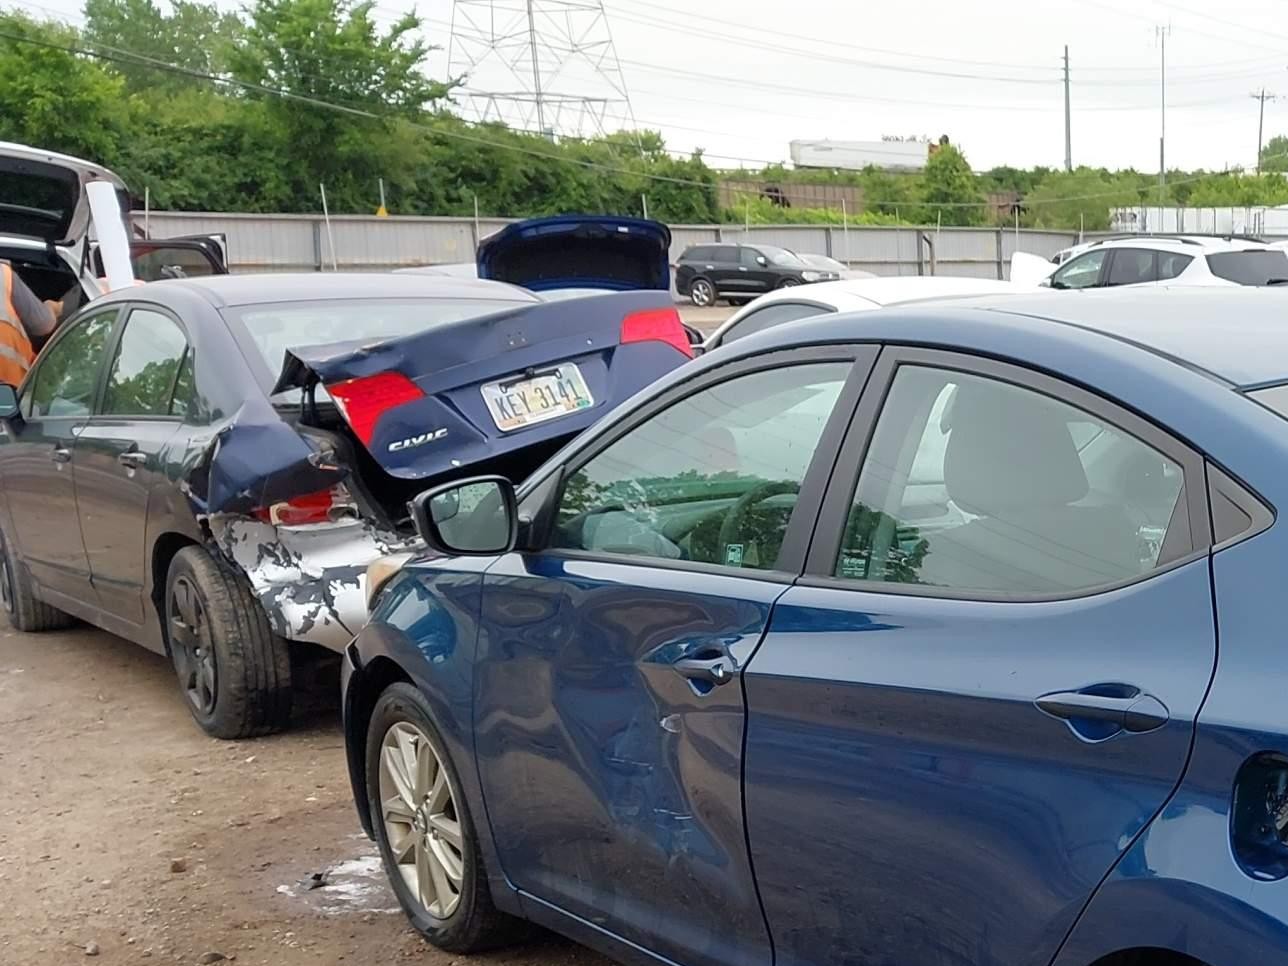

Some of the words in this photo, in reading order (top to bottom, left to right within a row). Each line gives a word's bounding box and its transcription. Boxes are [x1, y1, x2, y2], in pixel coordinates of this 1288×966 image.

[495, 391, 532, 420] KEY
[534, 379, 582, 409] 3141
[388, 427, 448, 452] CIVIC
